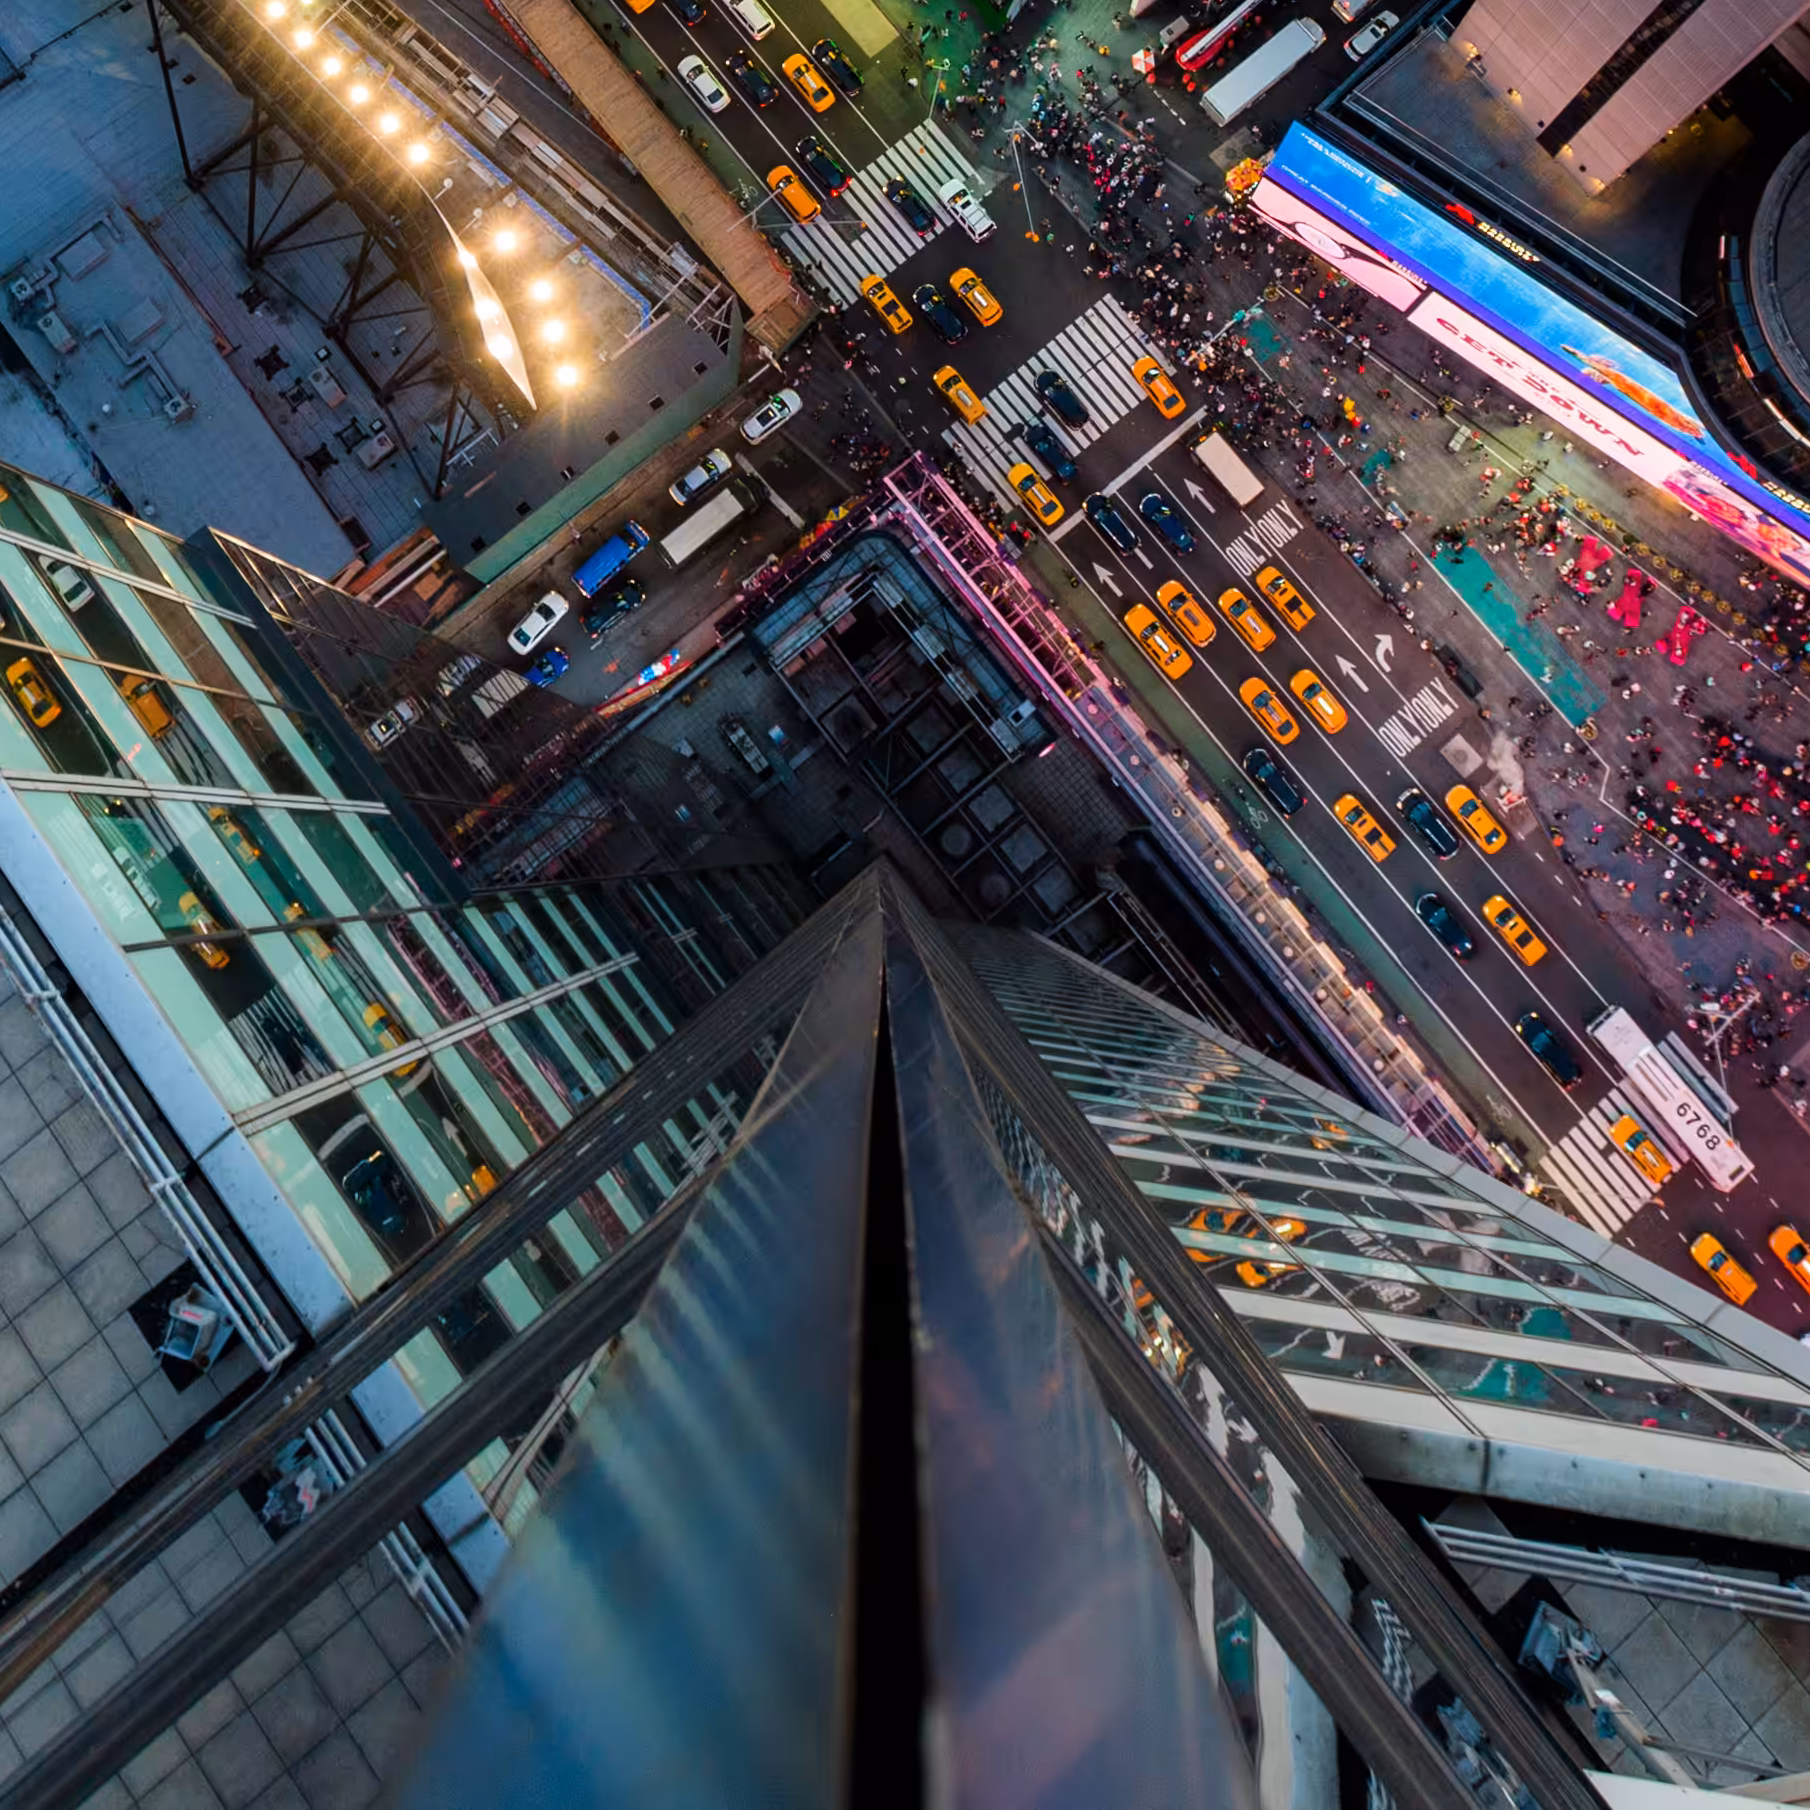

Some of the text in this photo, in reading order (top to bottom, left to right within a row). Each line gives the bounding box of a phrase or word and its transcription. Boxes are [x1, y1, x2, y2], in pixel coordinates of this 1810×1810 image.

[1436, 317, 1523, 370] GET
[1521, 374, 1645, 457] DOWN
[1256, 499, 1304, 548] ONLY
[1225, 527, 1273, 577] ONLY
[1378, 702, 1427, 758] ONLY
[1410, 677, 1460, 735] ONLY
[1676, 1101, 1721, 1151] 6768
